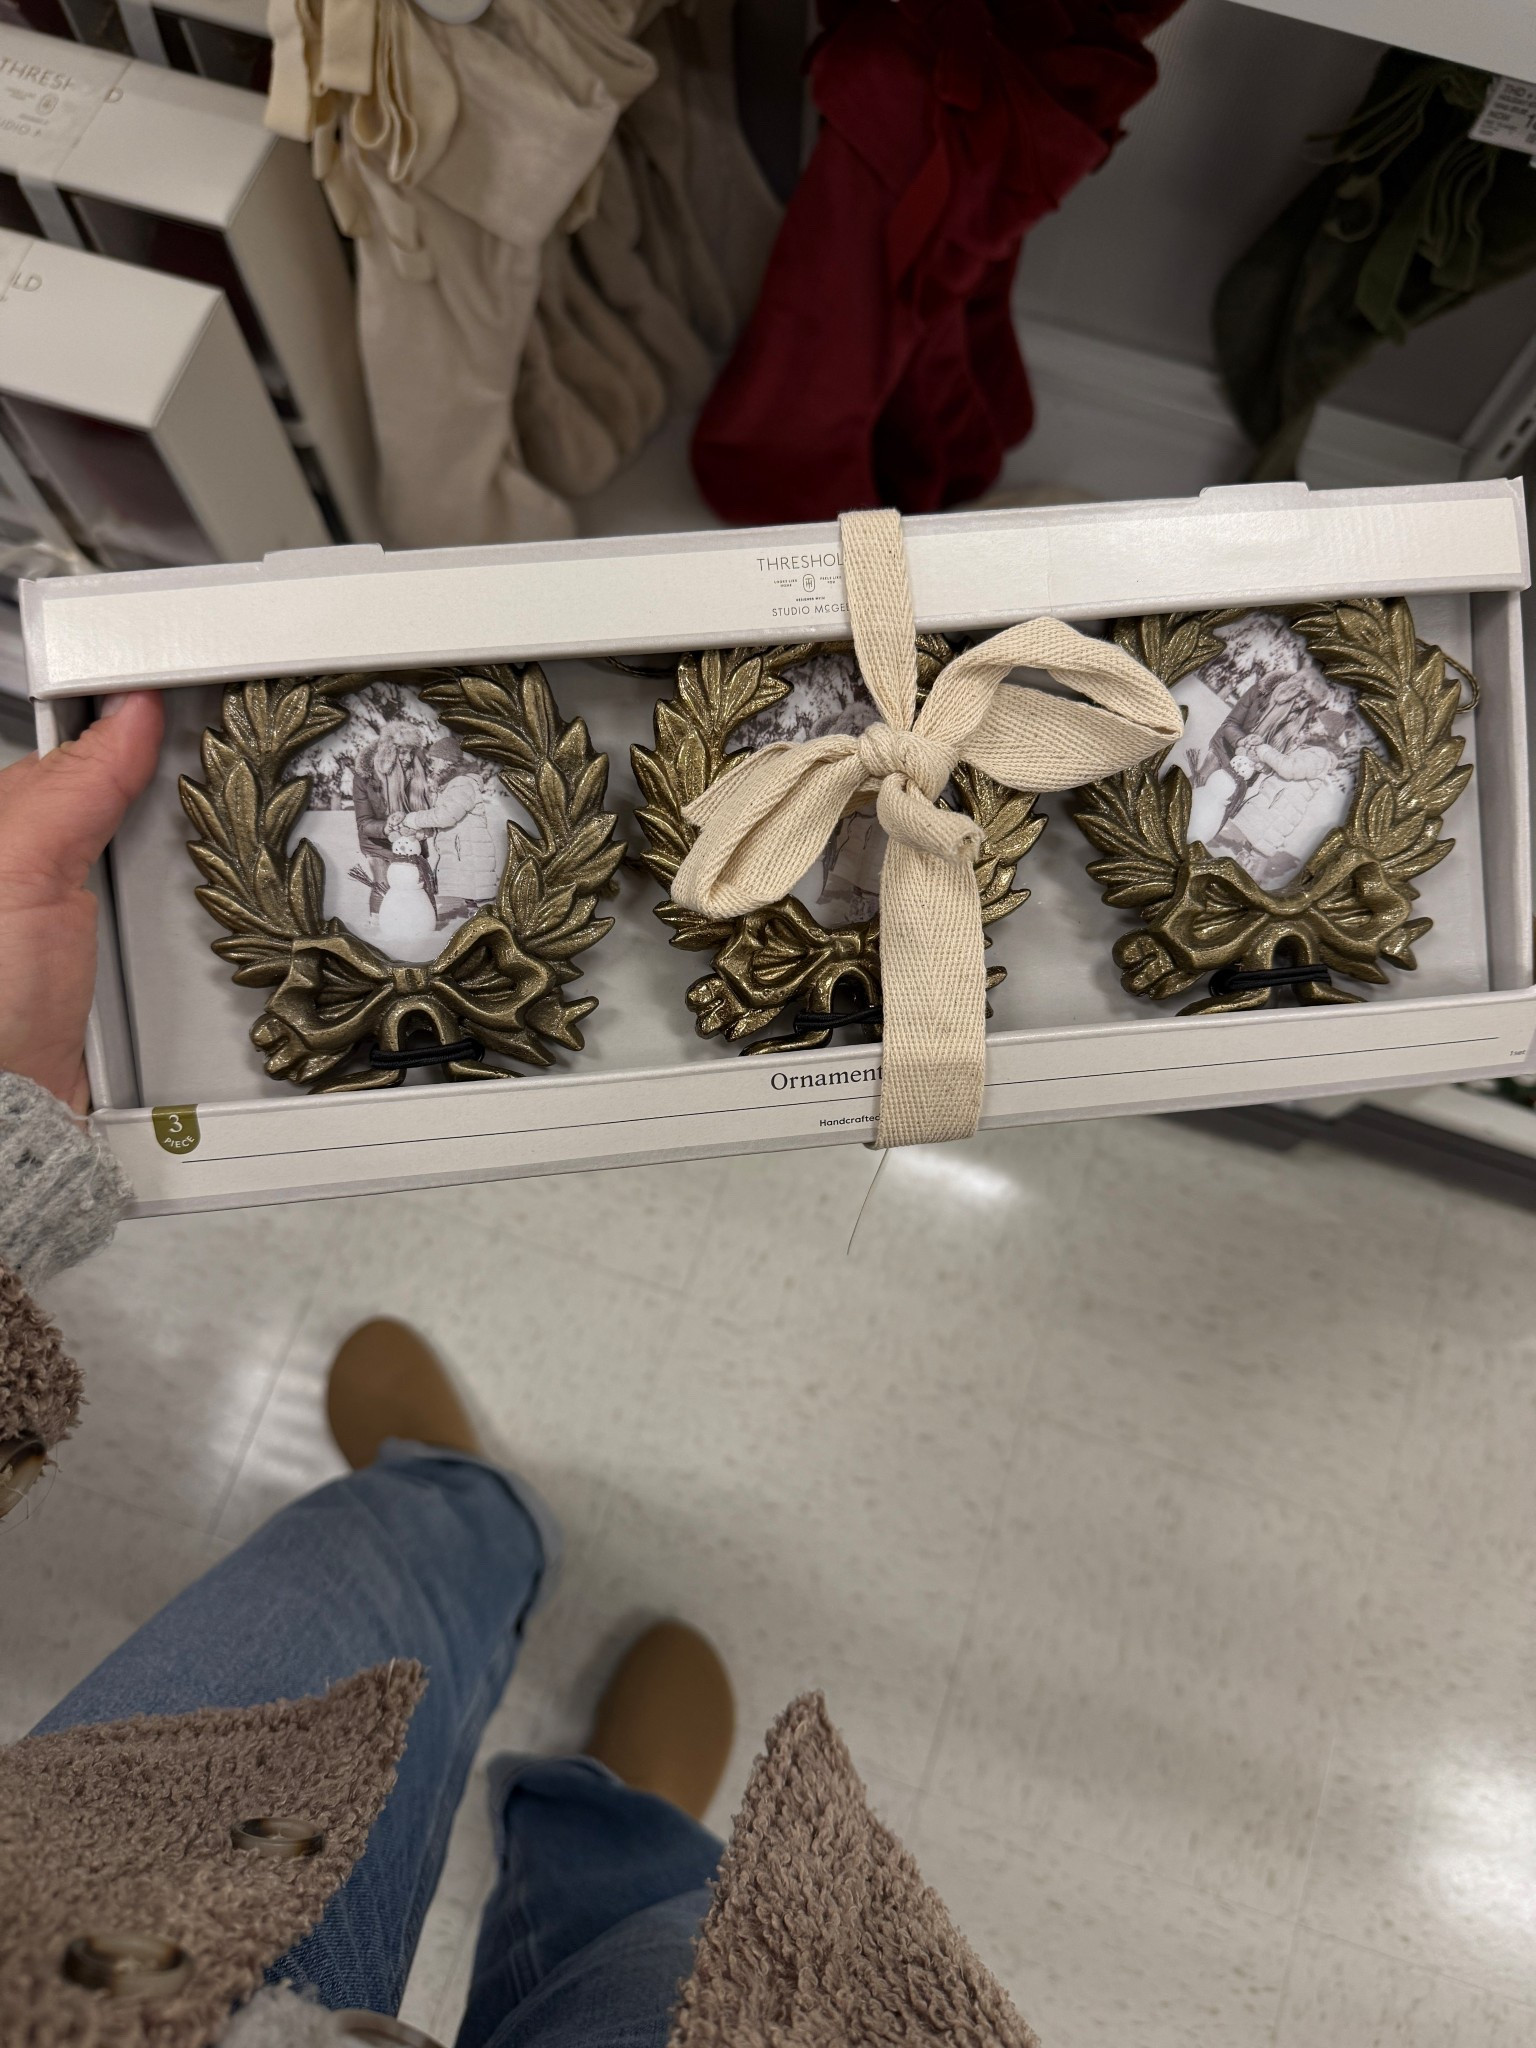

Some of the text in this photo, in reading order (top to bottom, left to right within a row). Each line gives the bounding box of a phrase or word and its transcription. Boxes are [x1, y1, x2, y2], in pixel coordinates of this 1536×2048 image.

[756, 553, 844, 571] THRESHOL
[772, 606, 810, 617] STUDIO
[169, 1114, 183, 1132] 3
[164, 1135, 195, 1148] PIECE
